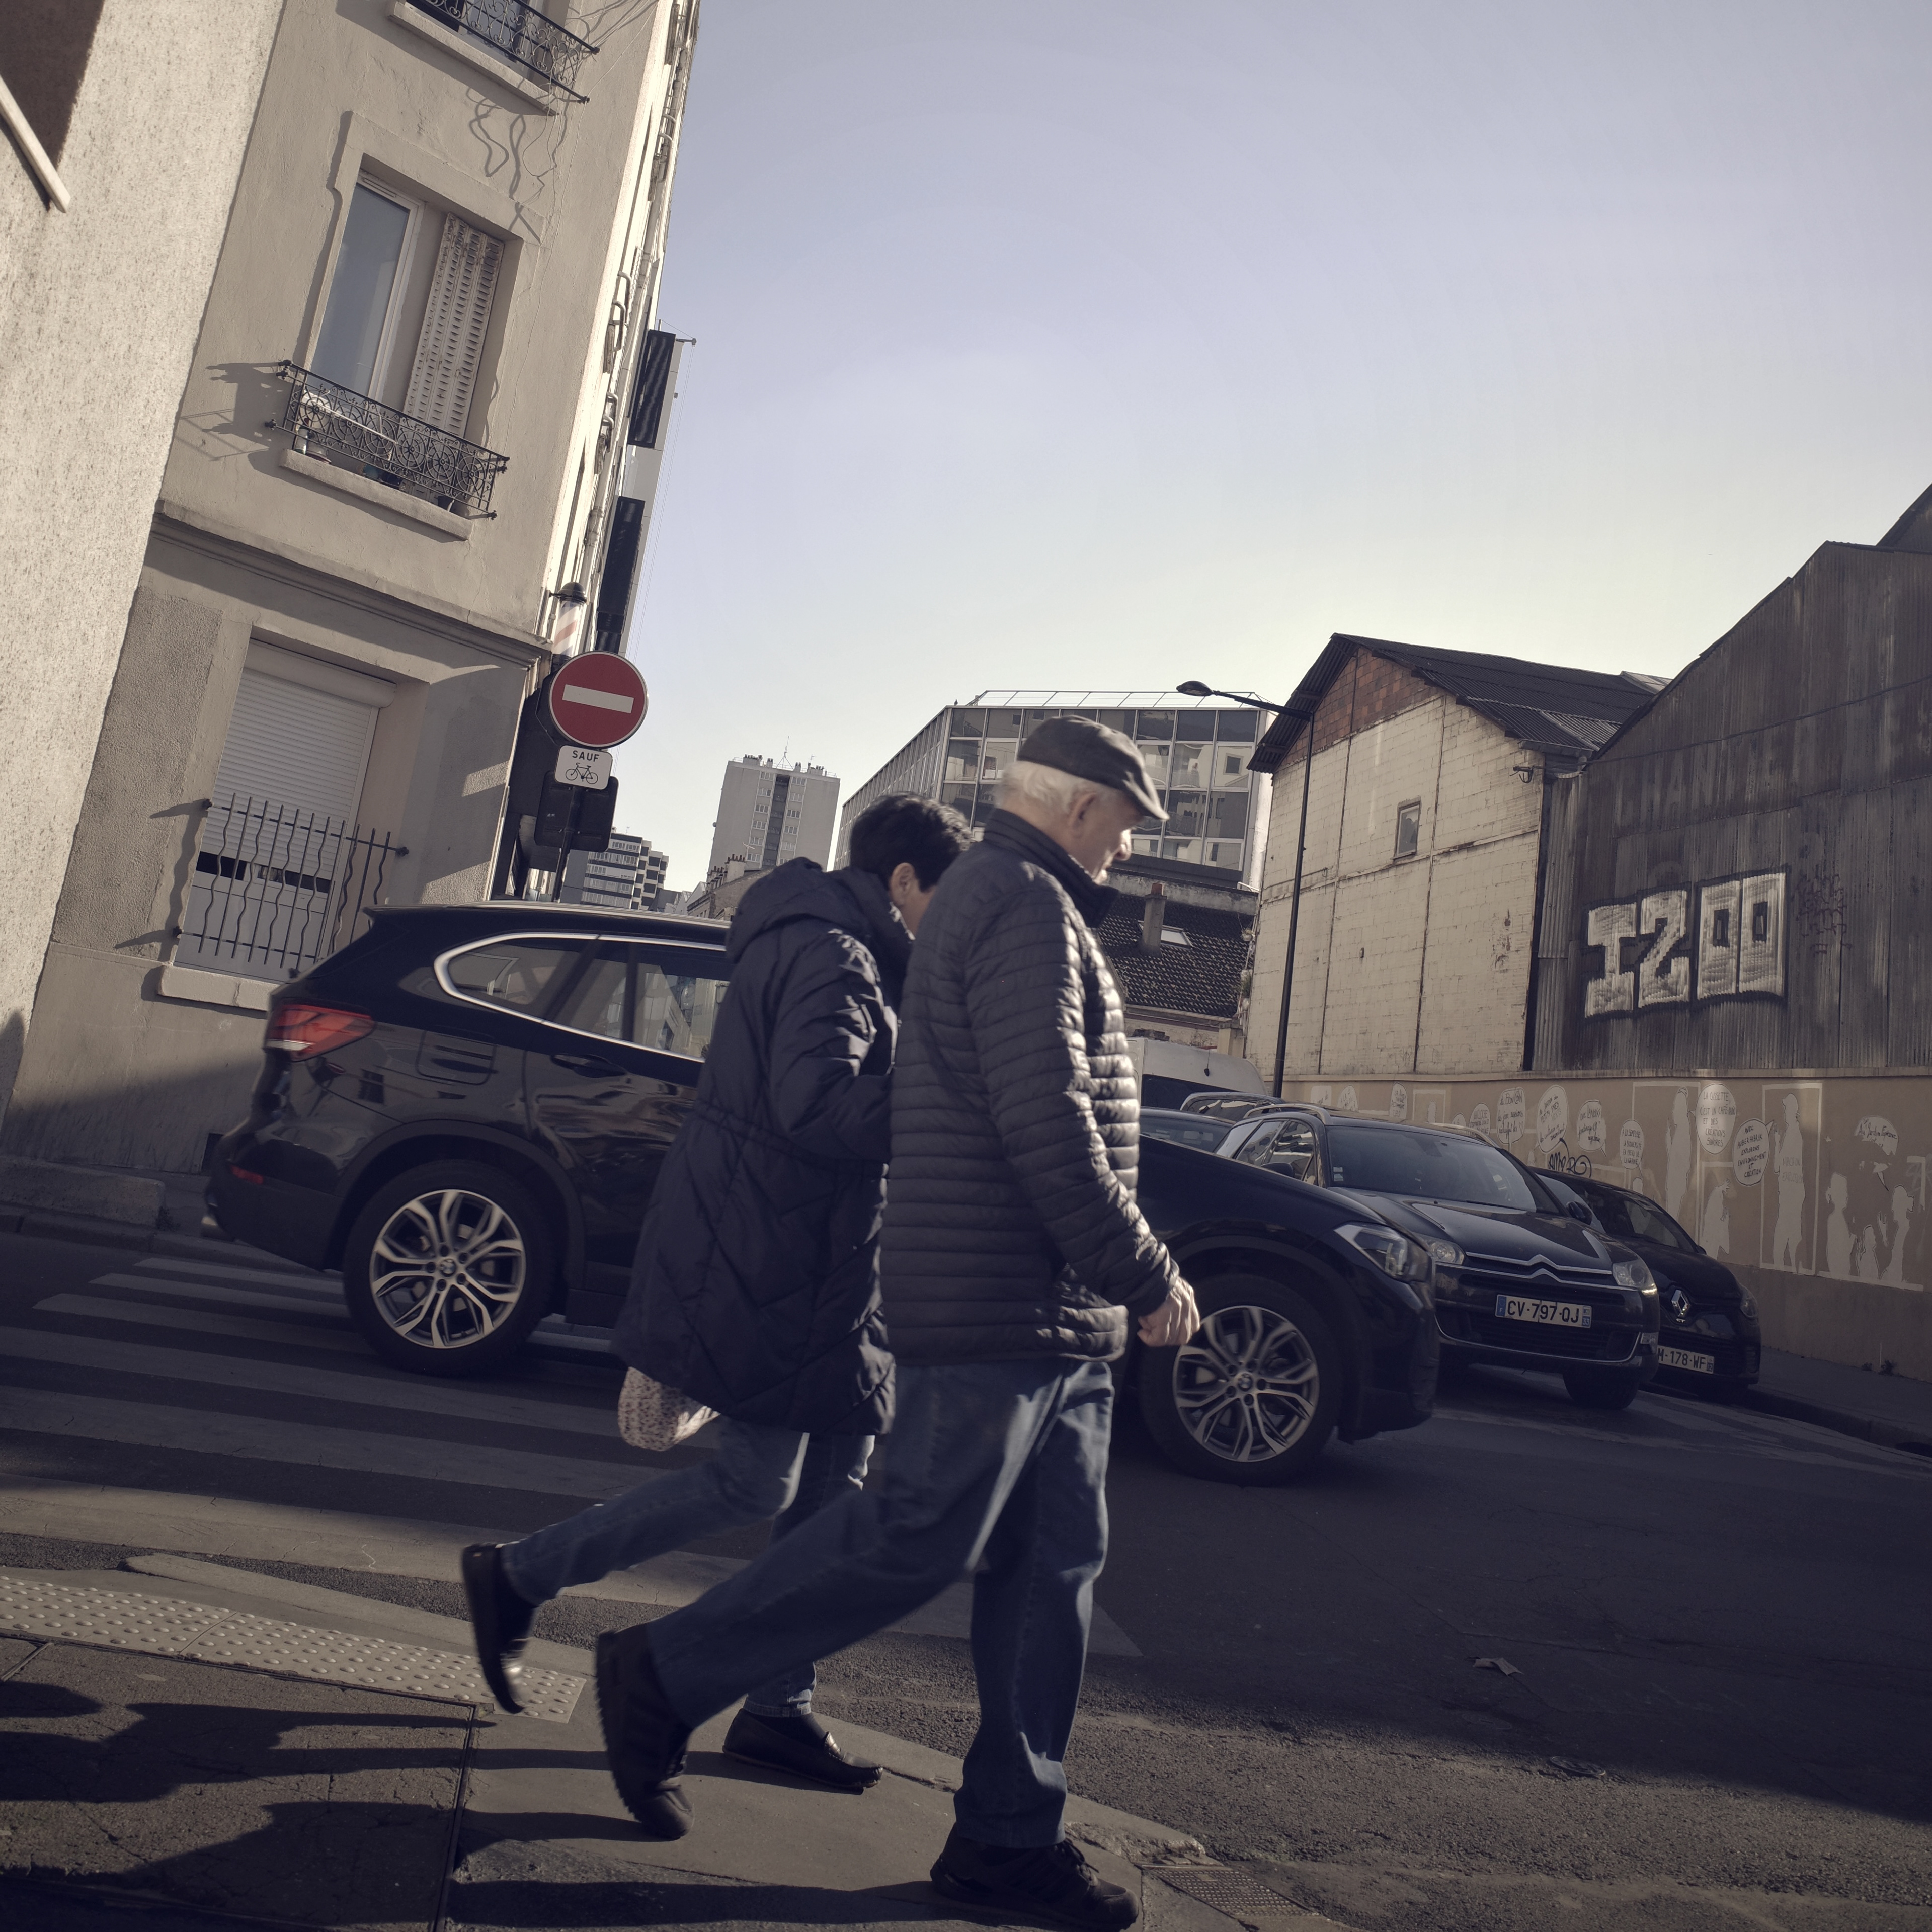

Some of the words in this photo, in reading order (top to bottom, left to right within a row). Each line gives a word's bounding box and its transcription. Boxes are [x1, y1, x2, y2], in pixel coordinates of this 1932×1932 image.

[572, 750, 600, 762] SAUF
[1703, 1092, 1708, 1100] LA
[1744, 1125, 1754, 1134] AVEC
[1507, 1300, 1579, 1323] CV-797-QJ
[1658, 1348, 1706, 1370] M-178-WF
